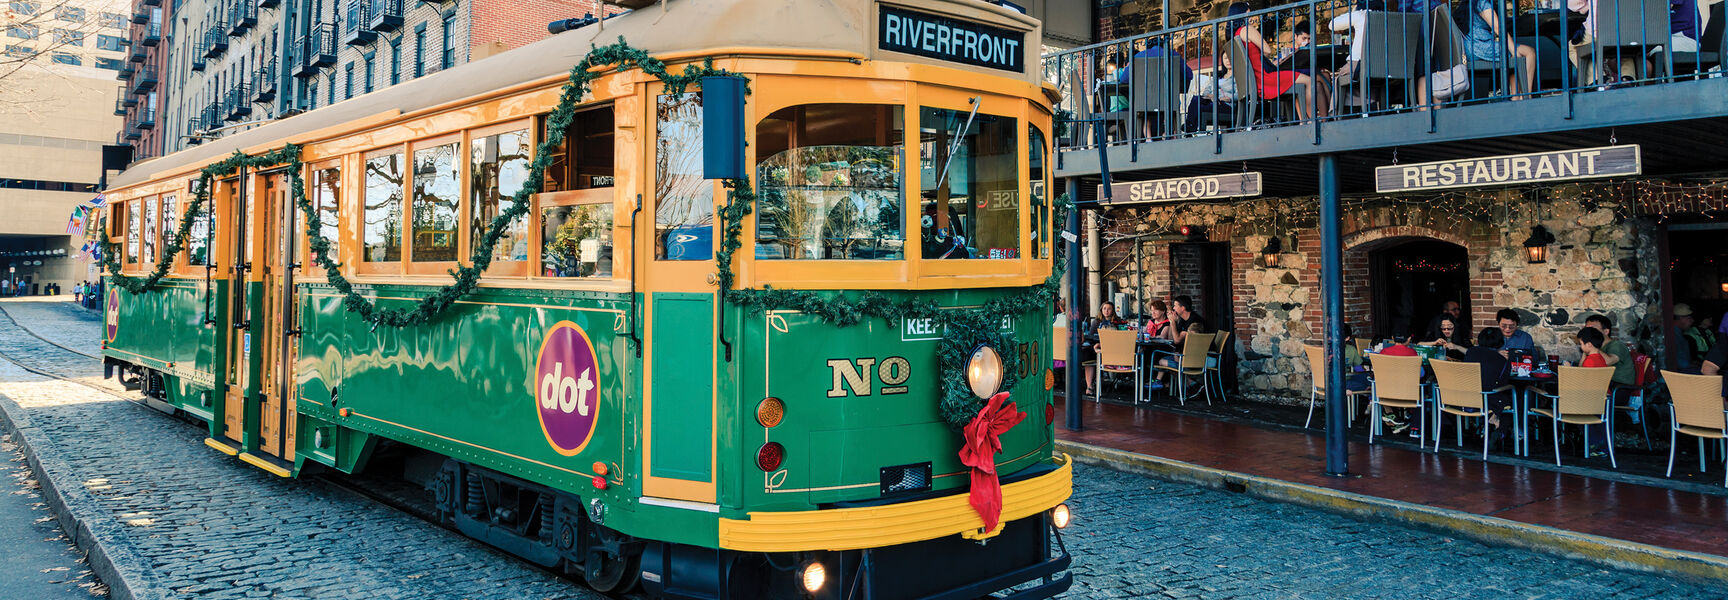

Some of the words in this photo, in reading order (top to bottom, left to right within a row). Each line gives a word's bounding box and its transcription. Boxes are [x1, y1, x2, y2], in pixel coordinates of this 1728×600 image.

[885, 13, 1019, 67] RIVERFRONT
[1402, 150, 1601, 188] RESTAURANT
[1129, 177, 1220, 201] SEAFOOD
[1017, 340, 1039, 379] 56
[541, 361, 595, 416] dot
